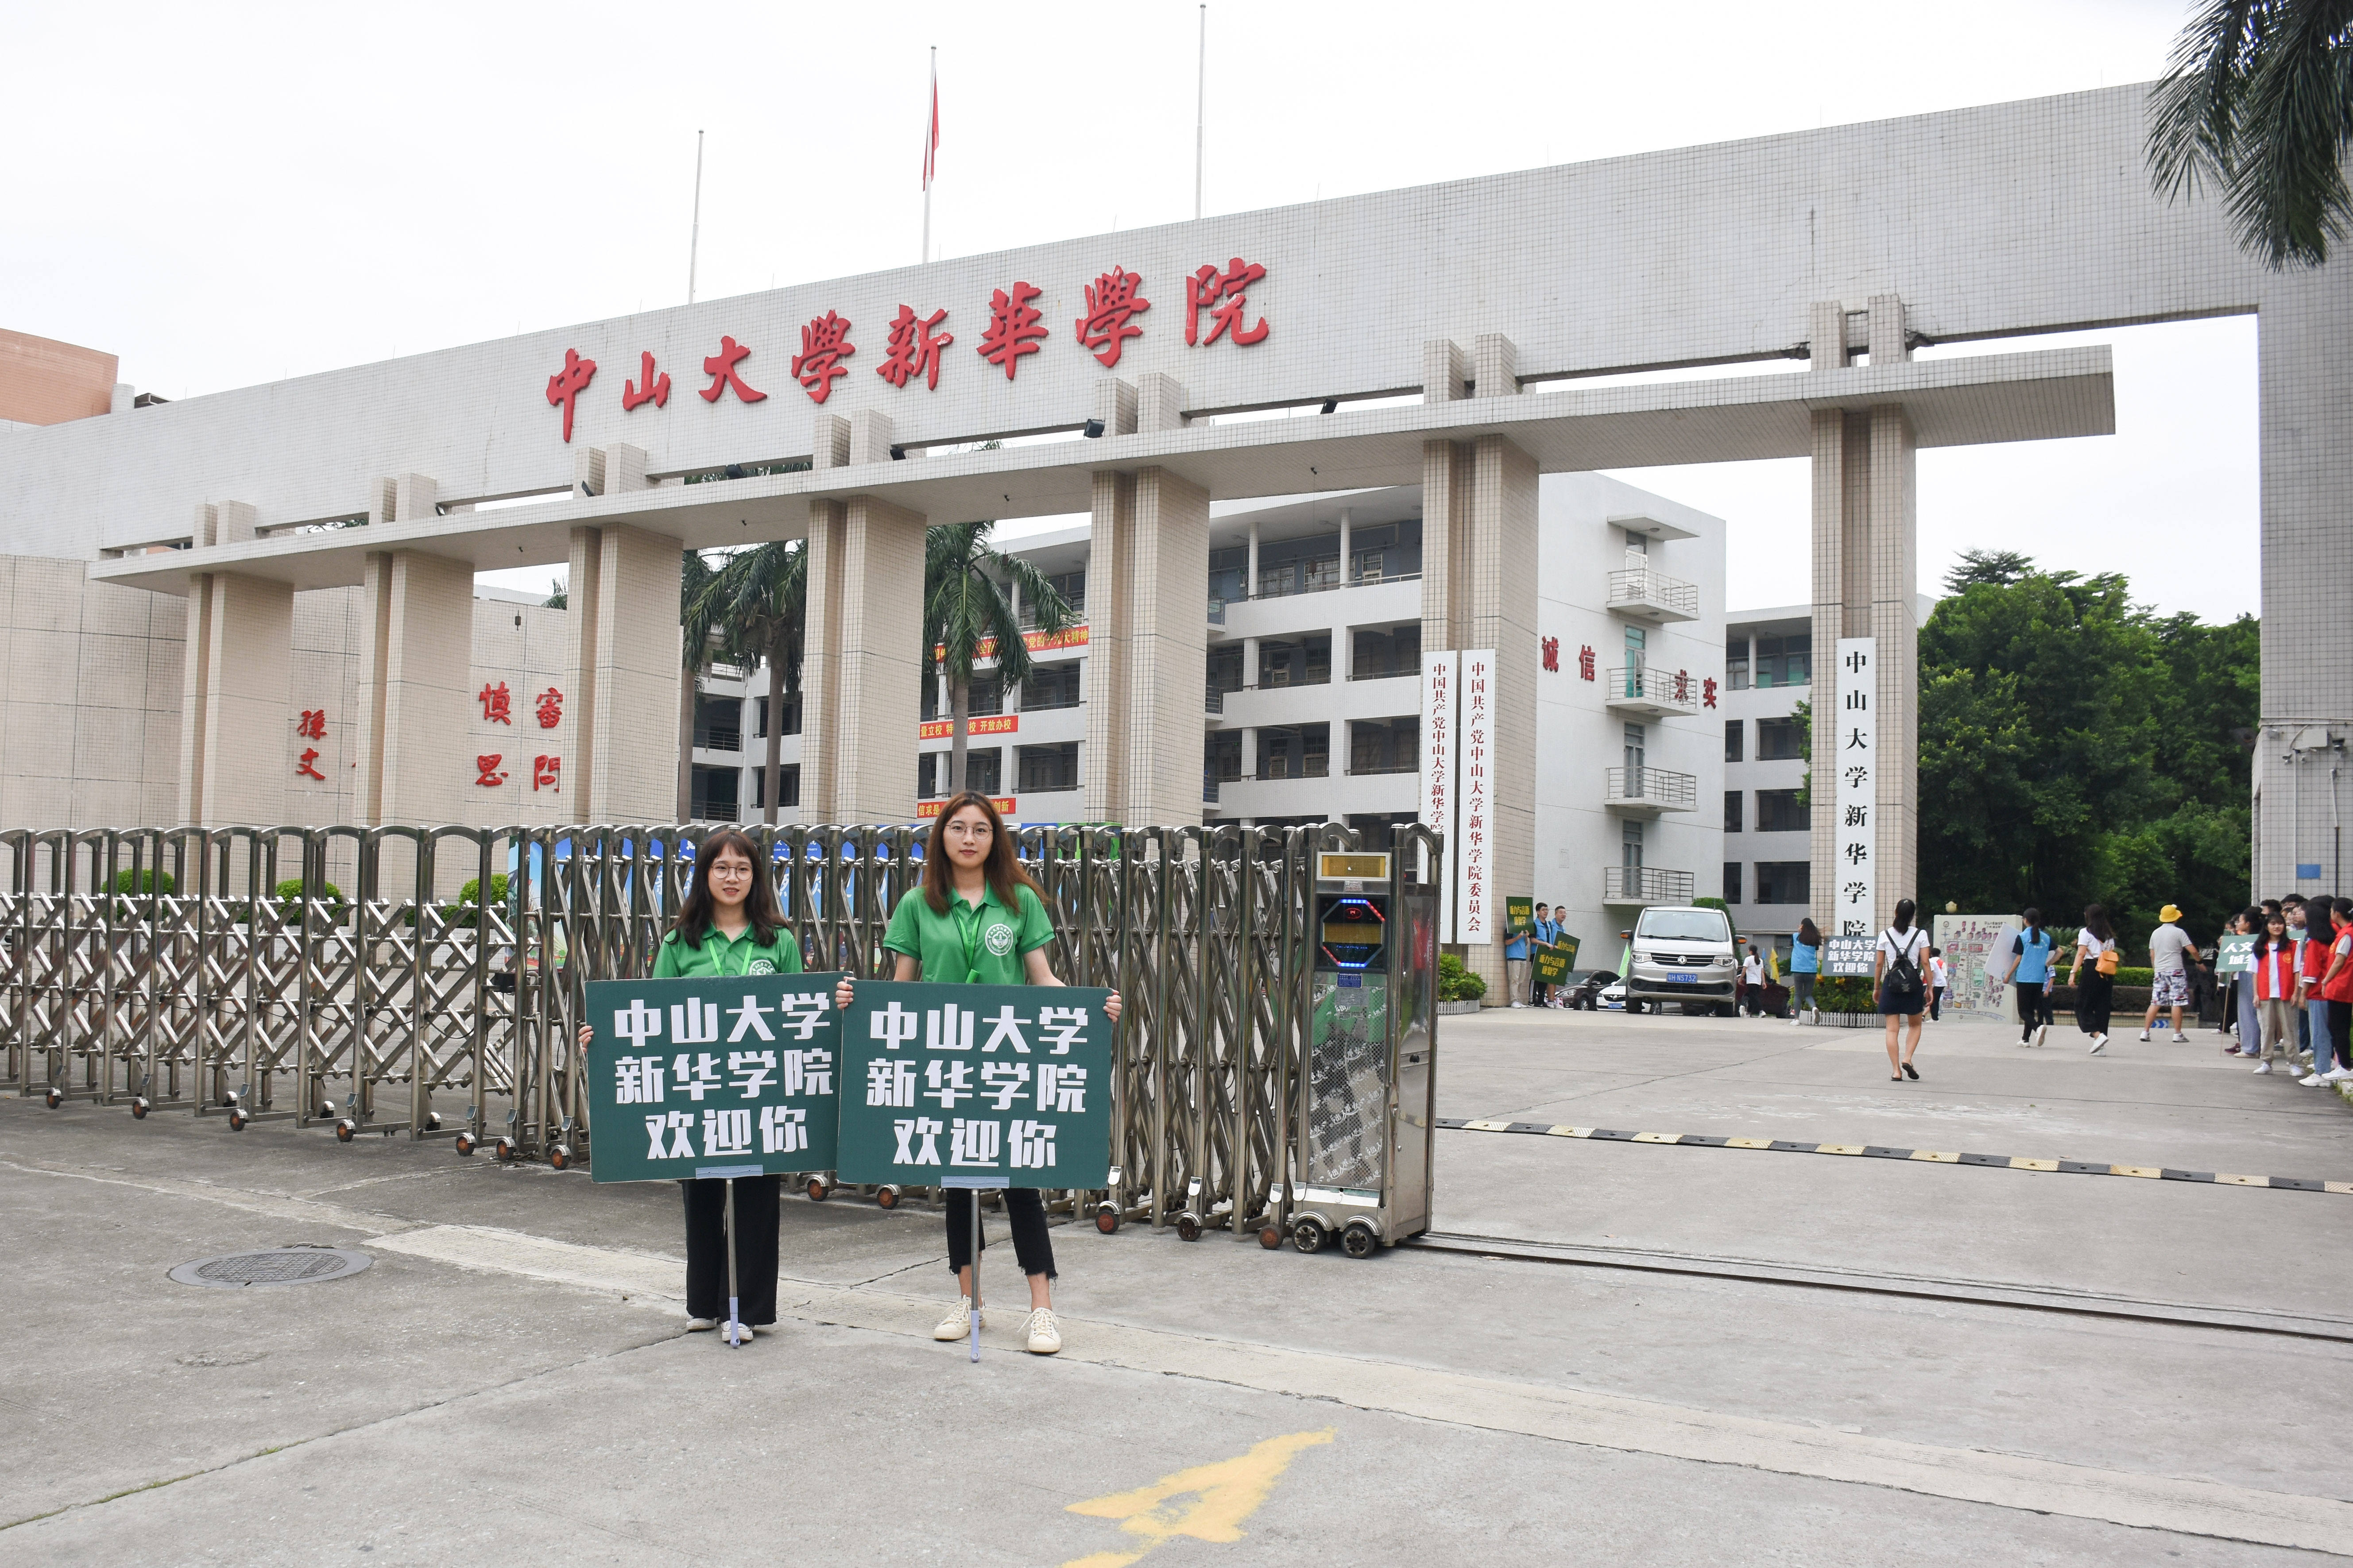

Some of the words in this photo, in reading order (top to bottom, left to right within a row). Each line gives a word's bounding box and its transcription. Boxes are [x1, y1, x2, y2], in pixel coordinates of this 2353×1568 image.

[546, 257, 1269, 442] 中山大學新華學院
[1542, 636, 1595, 681] 诚信
[980, 718, 1011, 732] 开放办校
[1467, 662, 1485, 931] 中国共产党中山大学新华学院委员会
[1844, 651, 1868, 935] 中山大学新华学院
[1827, 950, 1875, 962] 新华学院
[1829, 939, 1876, 950] 中山大学
[1833, 962, 1869, 973] 欢迎你
[614, 993, 830, 1047] 中山大学
[870, 1001, 1088, 1054] 中山大学
[615, 1048, 833, 1104] 新华学院
[867, 1058, 1087, 1112] 新华学院
[646, 1105, 808, 1159] 欢迎你
[893, 1116, 1057, 1168] 欢迎你
